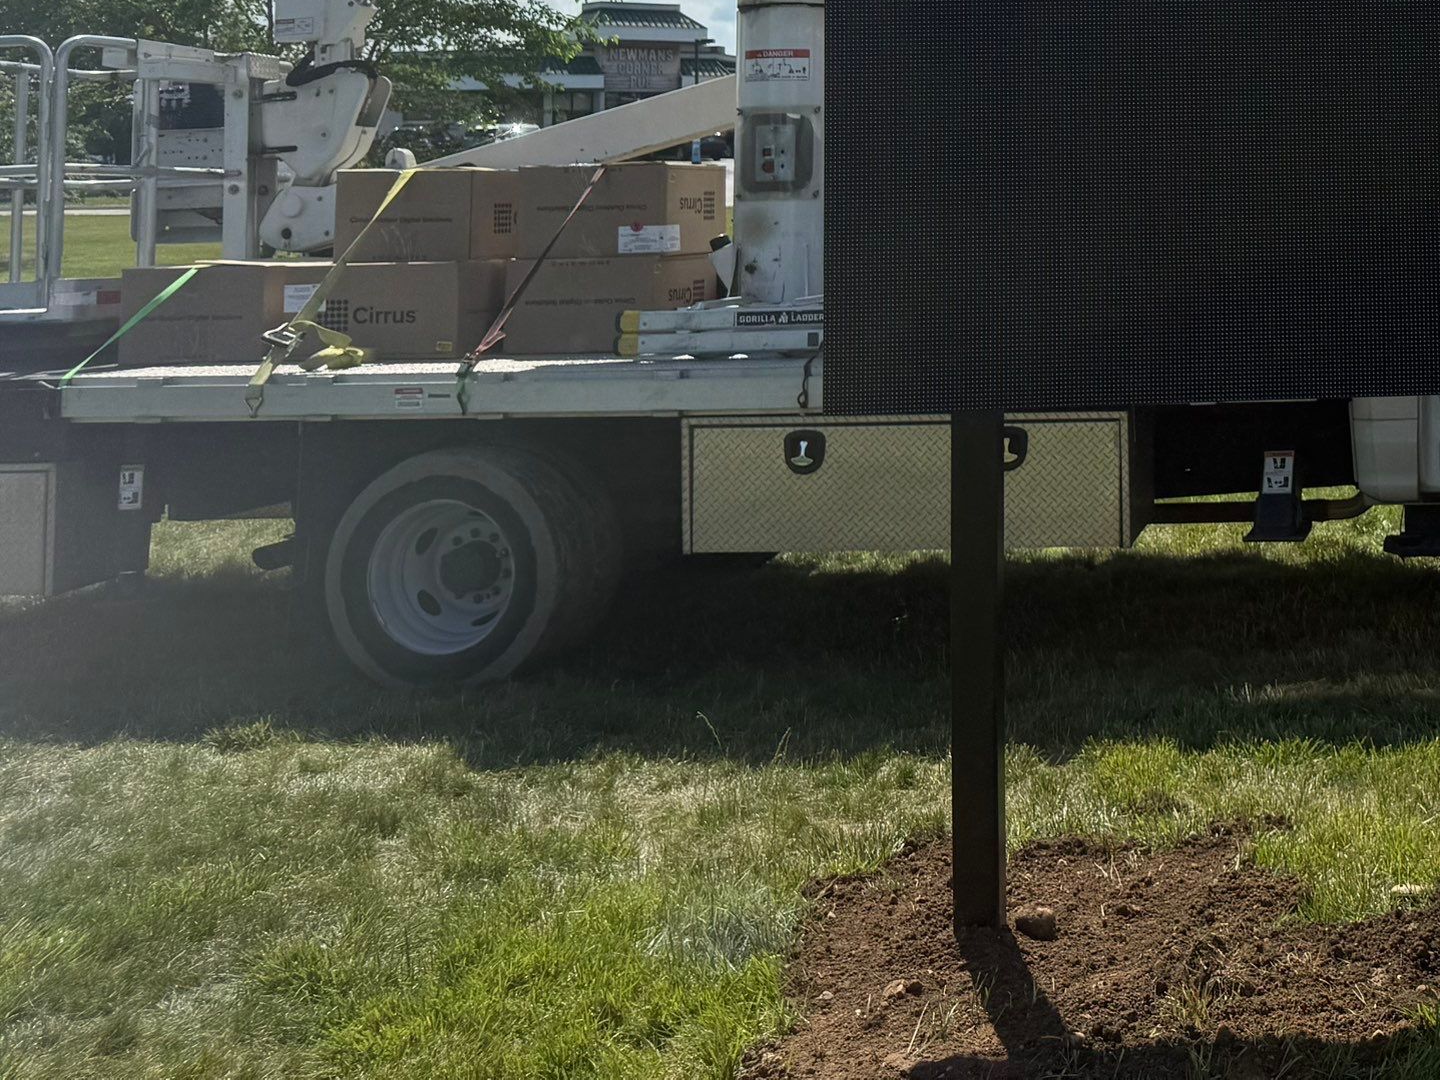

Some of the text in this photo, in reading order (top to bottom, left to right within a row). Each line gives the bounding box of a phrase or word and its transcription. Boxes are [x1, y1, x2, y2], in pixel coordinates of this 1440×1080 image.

[609, 47, 673, 61] NEWMANS
[680, 197, 703, 214] Cirrus
[668, 287, 692, 303] Cirrus
[352, 306, 417, 324] Cirrus
[739, 314, 776, 324] GORILLA
